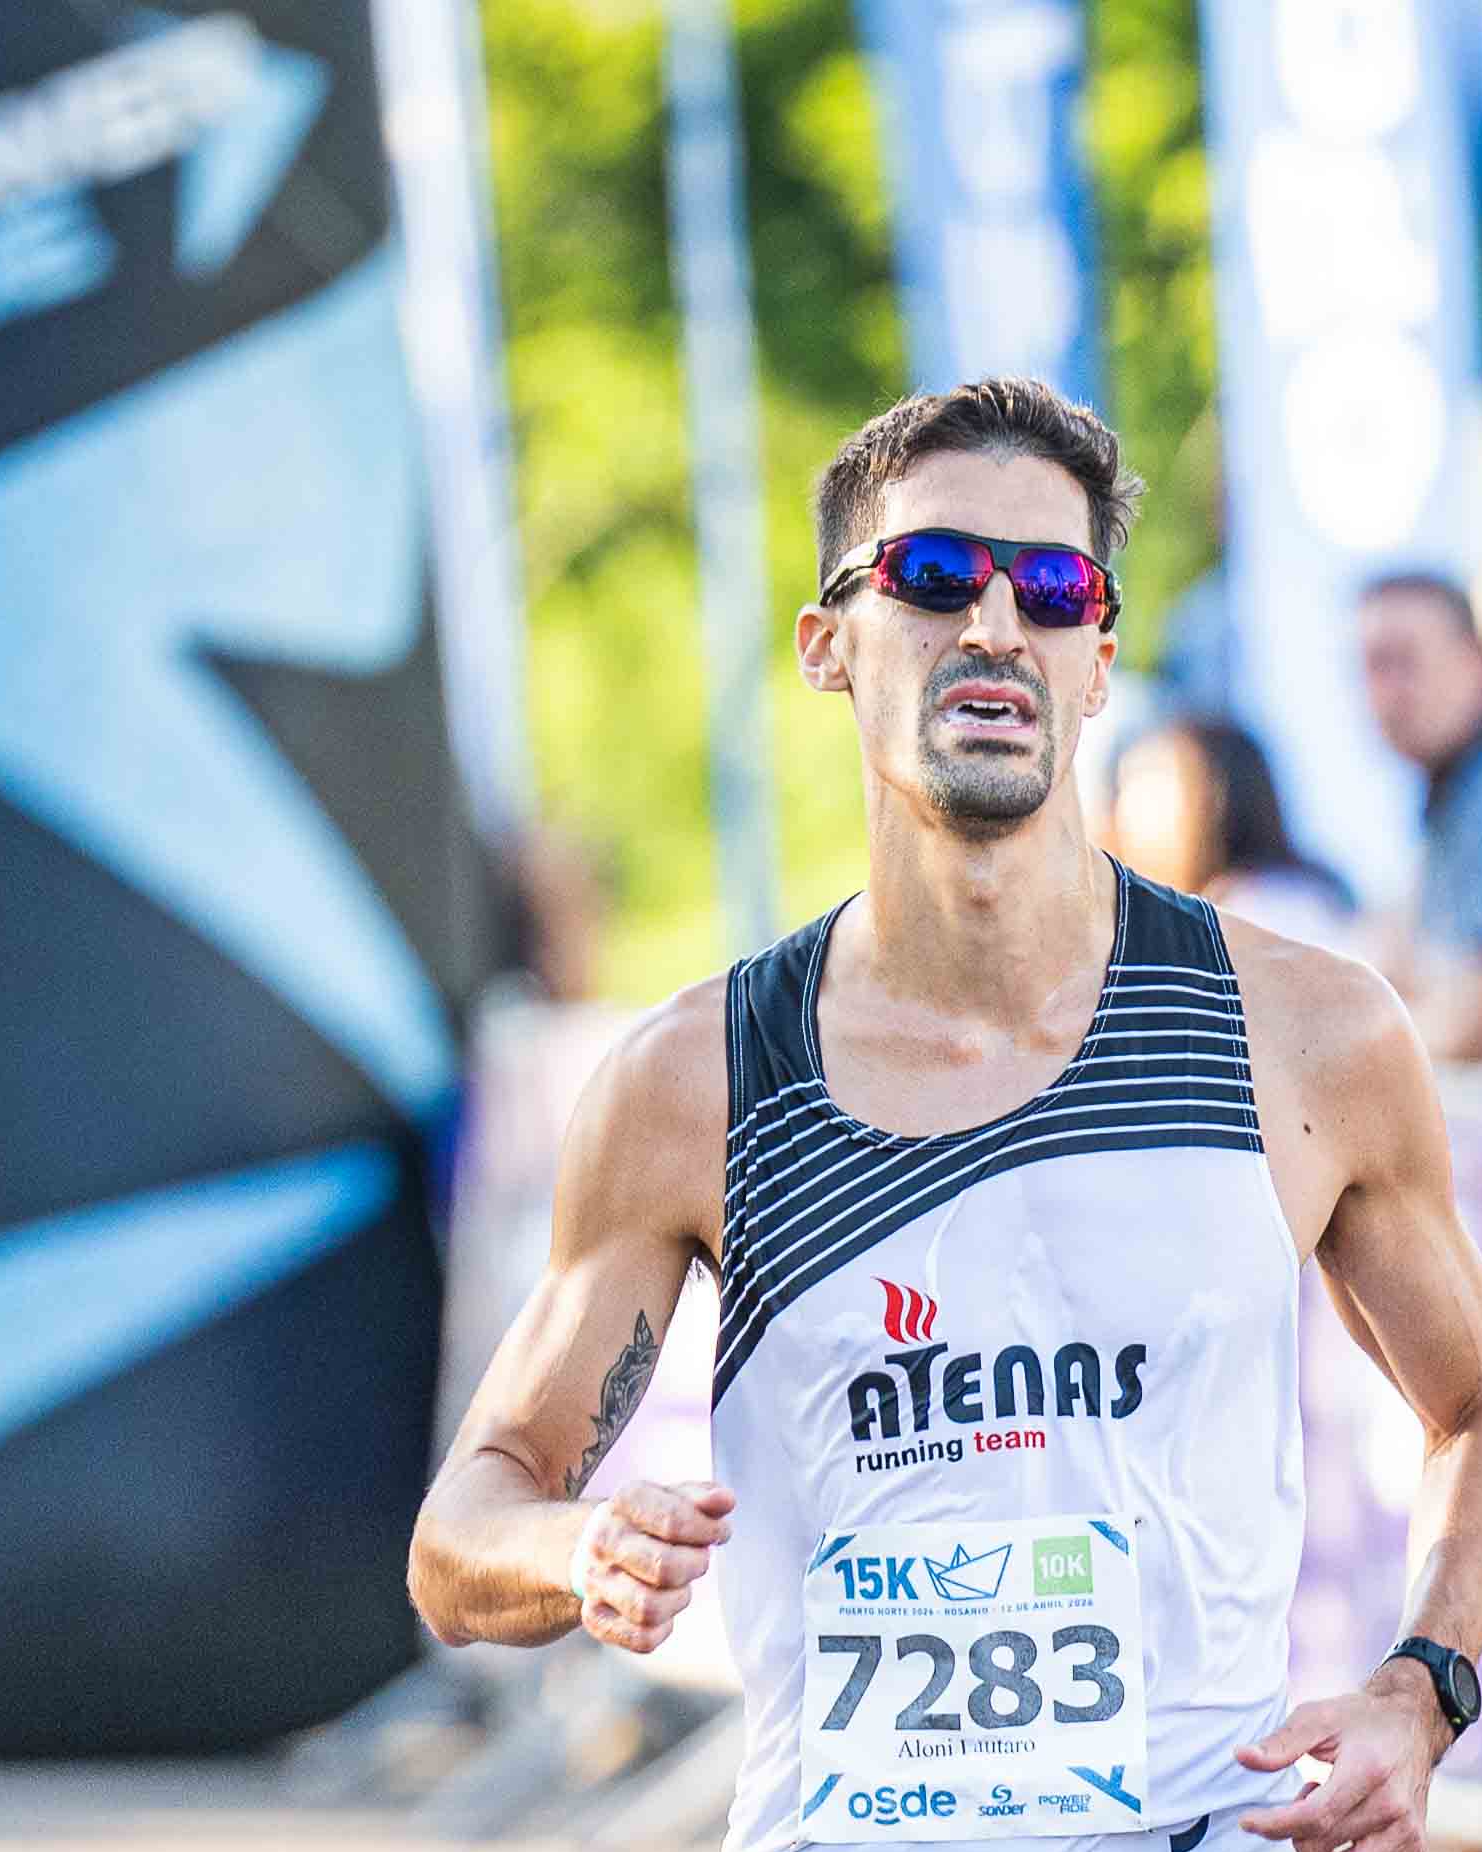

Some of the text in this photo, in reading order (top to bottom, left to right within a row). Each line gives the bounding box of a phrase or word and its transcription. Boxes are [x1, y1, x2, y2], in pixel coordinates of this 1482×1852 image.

[847, 1342, 1147, 1441] ATENAS
[856, 1429, 1046, 1473] running team
[833, 1556, 919, 1601] 15K
[1040, 1554, 1087, 1582] 10K
[839, 1607, 875, 1616] PUERTO
[878, 1607, 907, 1616] NORTE
[944, 1606, 989, 1616] ROSARIO
[1032, 1600, 1063, 1610] ABRIL
[1069, 1598, 1094, 1608] 2026
[818, 1625, 1125, 1732] 7283
[898, 1738, 954, 1760] Aloni
[847, 1783, 957, 1825] osde
